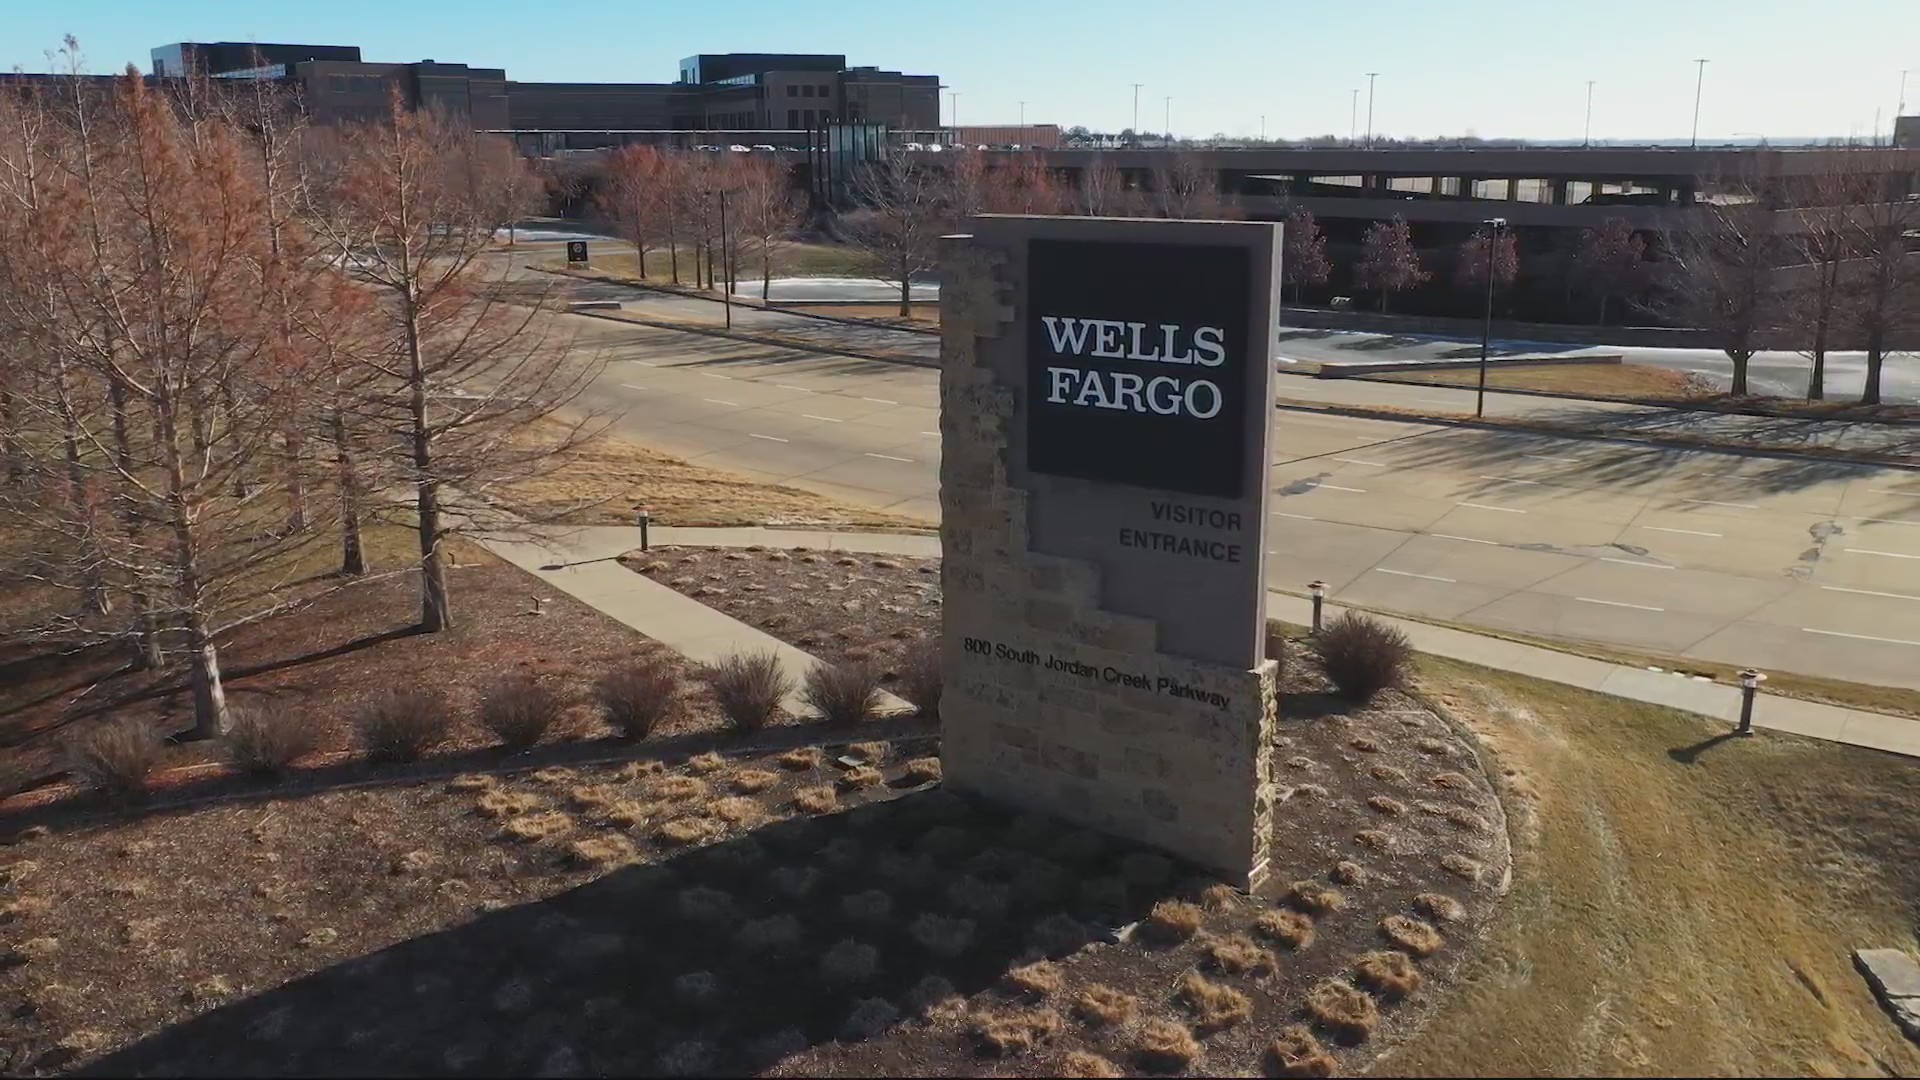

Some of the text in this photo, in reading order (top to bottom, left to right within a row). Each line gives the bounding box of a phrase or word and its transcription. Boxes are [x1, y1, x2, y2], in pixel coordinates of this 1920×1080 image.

[1042, 316, 1226, 367] WELLS
[1047, 367, 1223, 419] FARGO
[1151, 502, 1241, 532] VISITOR
[1119, 528, 1241, 563] ENTRANCE
[964, 637, 1231, 711] 800 South Jordan Creek Parkway
